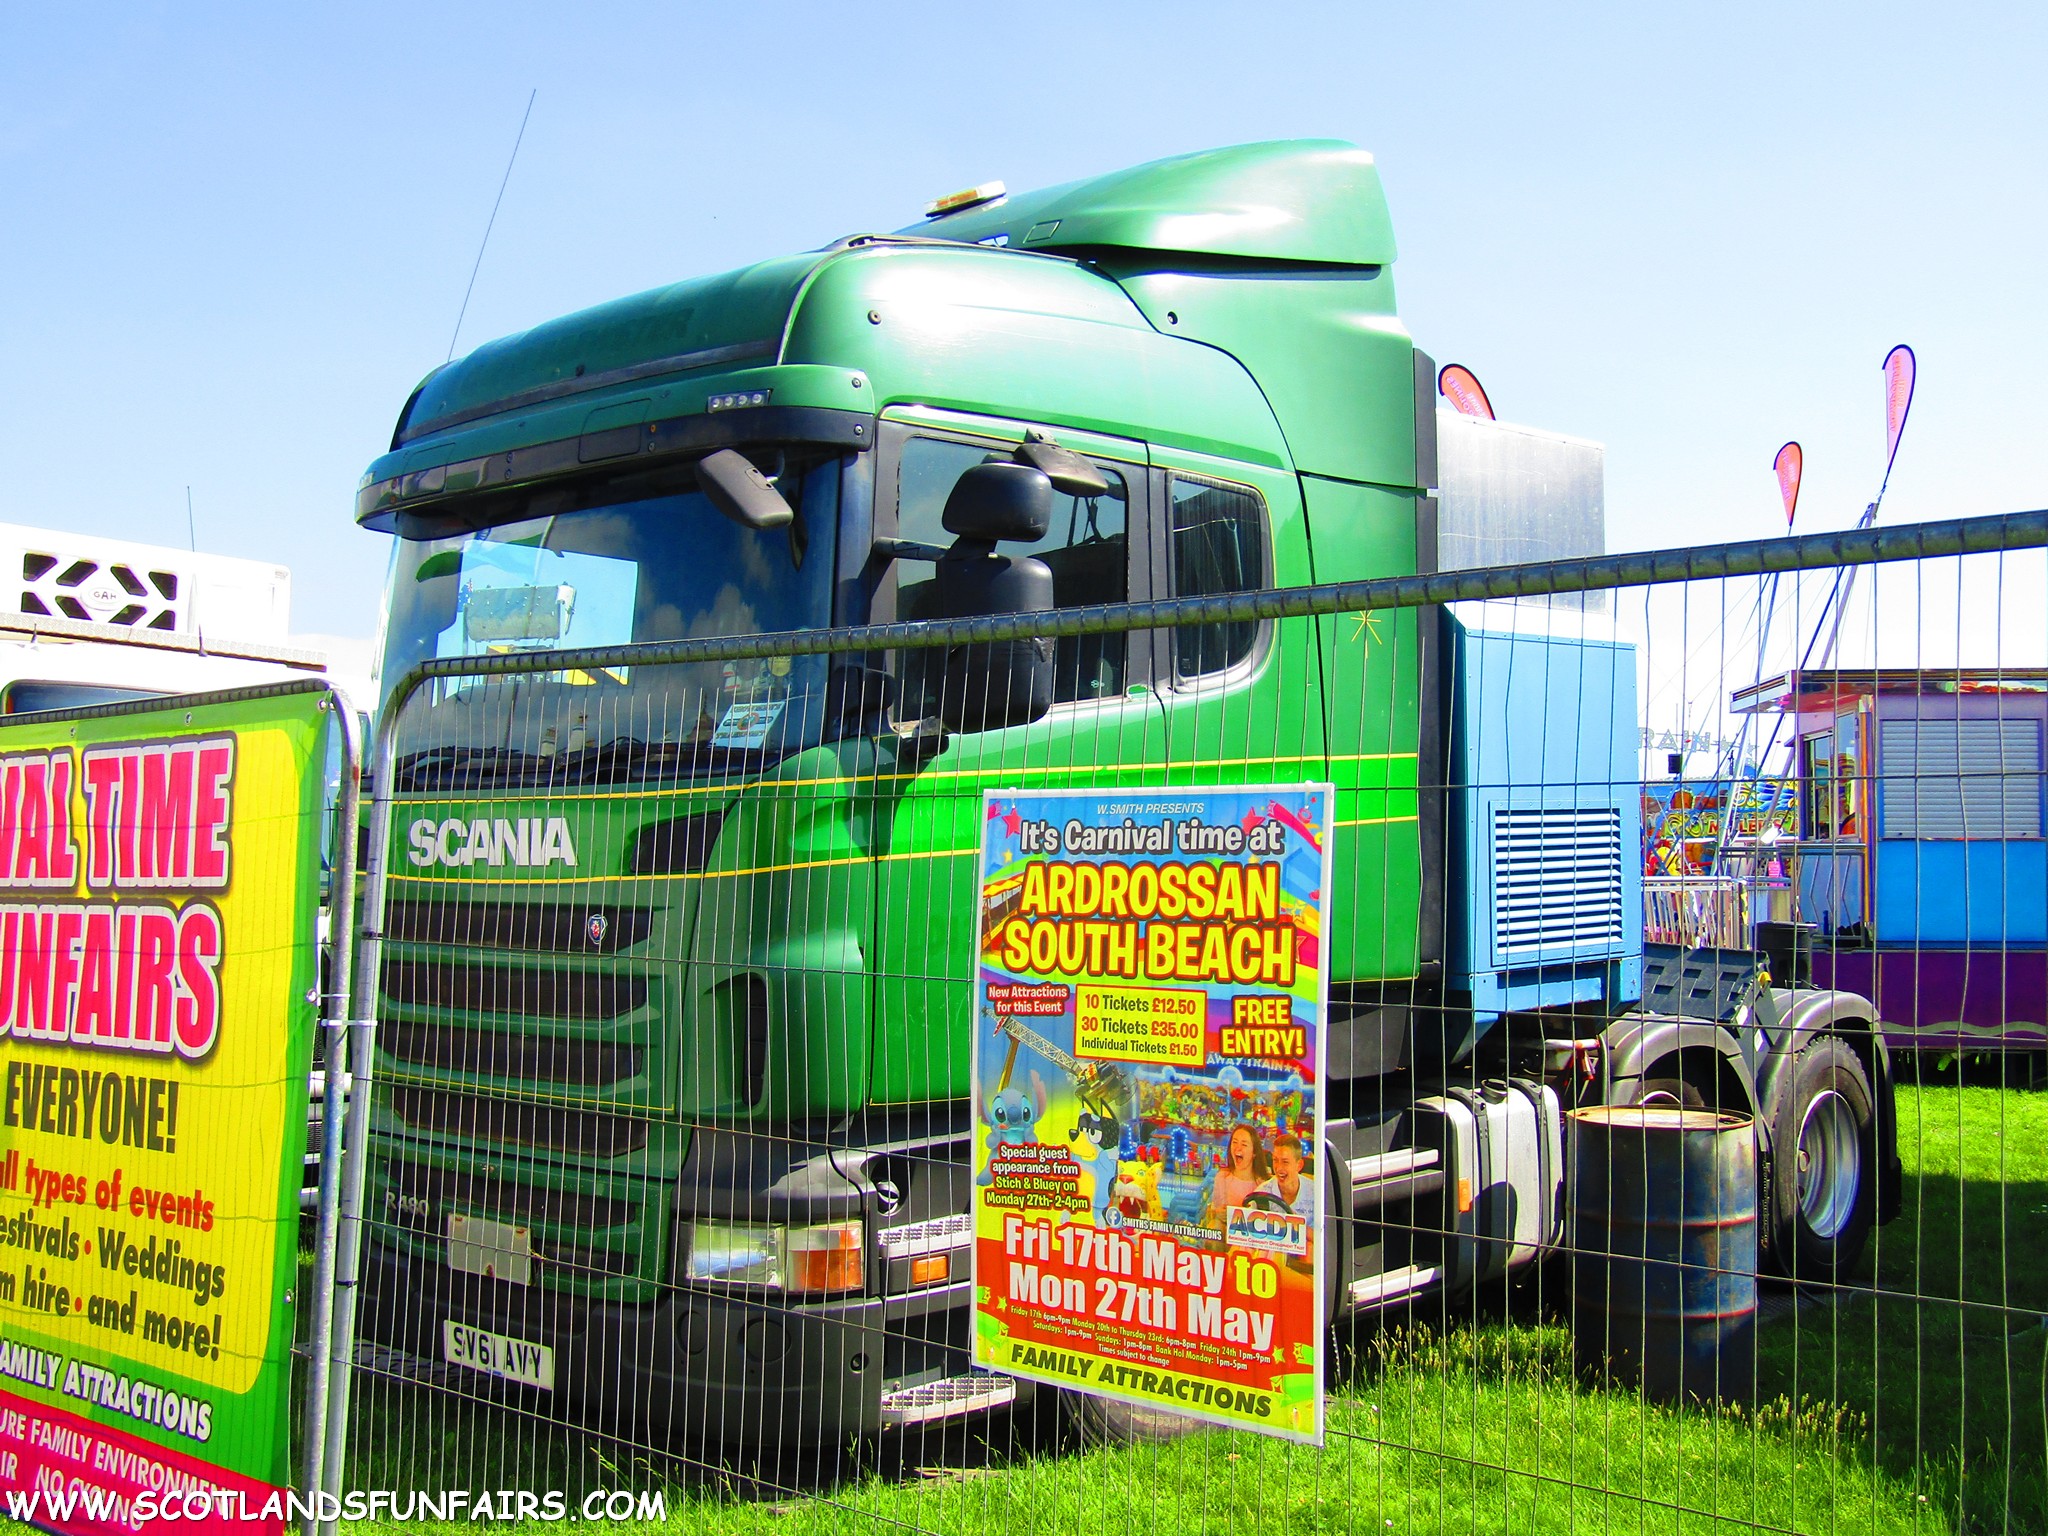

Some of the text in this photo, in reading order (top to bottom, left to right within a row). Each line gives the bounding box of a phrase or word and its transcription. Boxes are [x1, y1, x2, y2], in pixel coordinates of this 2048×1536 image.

[84, 738, 234, 887] TIME
[1146, 802, 1204, 814] PRESENTS
[408, 817, 579, 867] SCANIA
[1020, 819, 1281, 851] It's Carnival time at
[1020, 863, 1280, 920] ARDROSSAN
[1003, 919, 1294, 982] SOUTH BEACH
[989, 986, 1067, 998] New Attractions
[996, 1001, 1062, 1013] for this Event
[1085, 994, 1196, 1015] 10 Tickets £12.50
[1081, 1017, 1199, 1038] 30 Tickets £35.00
[1234, 999, 1290, 1025] FREE
[1081, 1037, 1197, 1057] Individual Tickets £1.50
[1223, 1028, 1304, 1055] ENTRY!
[4, 1060, 180, 1154] EVERYONE!
[992, 1162, 1078, 1175] appearance from
[1001, 1145, 1068, 1162] Special guest
[26, 1158, 87, 1209] types
[95, 1168, 122, 1211] of
[129, 1186, 215, 1232] events
[986, 1192, 1025, 1209] Monday
[1055, 1195, 1088, 1211] 2-4pm
[996, 1176, 1076, 1194] Stich & Bluey on
[1122, 1217, 1148, 1230] SMITHS
[1149, 1220, 1174, 1233] FAMILY
[1174, 1225, 1222, 1241] ATTRACTIONS
[1229, 1208, 1306, 1244] ACDT
[98, 1226, 226, 1306] Weddings
[1005, 1217, 1277, 1298] Fri 17th May to
[22, 1264, 70, 1317] hire
[88, 1291, 138, 1335] and
[143, 1315, 222, 1361] more!
[1009, 1261, 1274, 1351] Mon 27th May
[1011, 1306, 1028, 1317] Friday
[1029, 1309, 1042, 1319] 17th
[1072, 1318, 1095, 1330] Monday
[1111, 1326, 1118, 1334] to
[1119, 1326, 1146, 1341] Thursday
[1200, 1343, 1220, 1355] Friday
[1222, 1347, 1237, 1357] 24th
[1239, 1350, 1271, 1364] 1pm-9pm
[1155, 1345, 1172, 1356] Bank
[1174, 1348, 1184, 1358] Hol
[1098, 1344, 1170, 1366] Times subject to change
[1011, 1343, 1272, 1418] FAMILY ATTRACTIONS
[64, 1360, 213, 1442] ATTRACTIONS
[30, 1419, 92, 1463] FAMILY
[35, 1464, 64, 1498] NO
